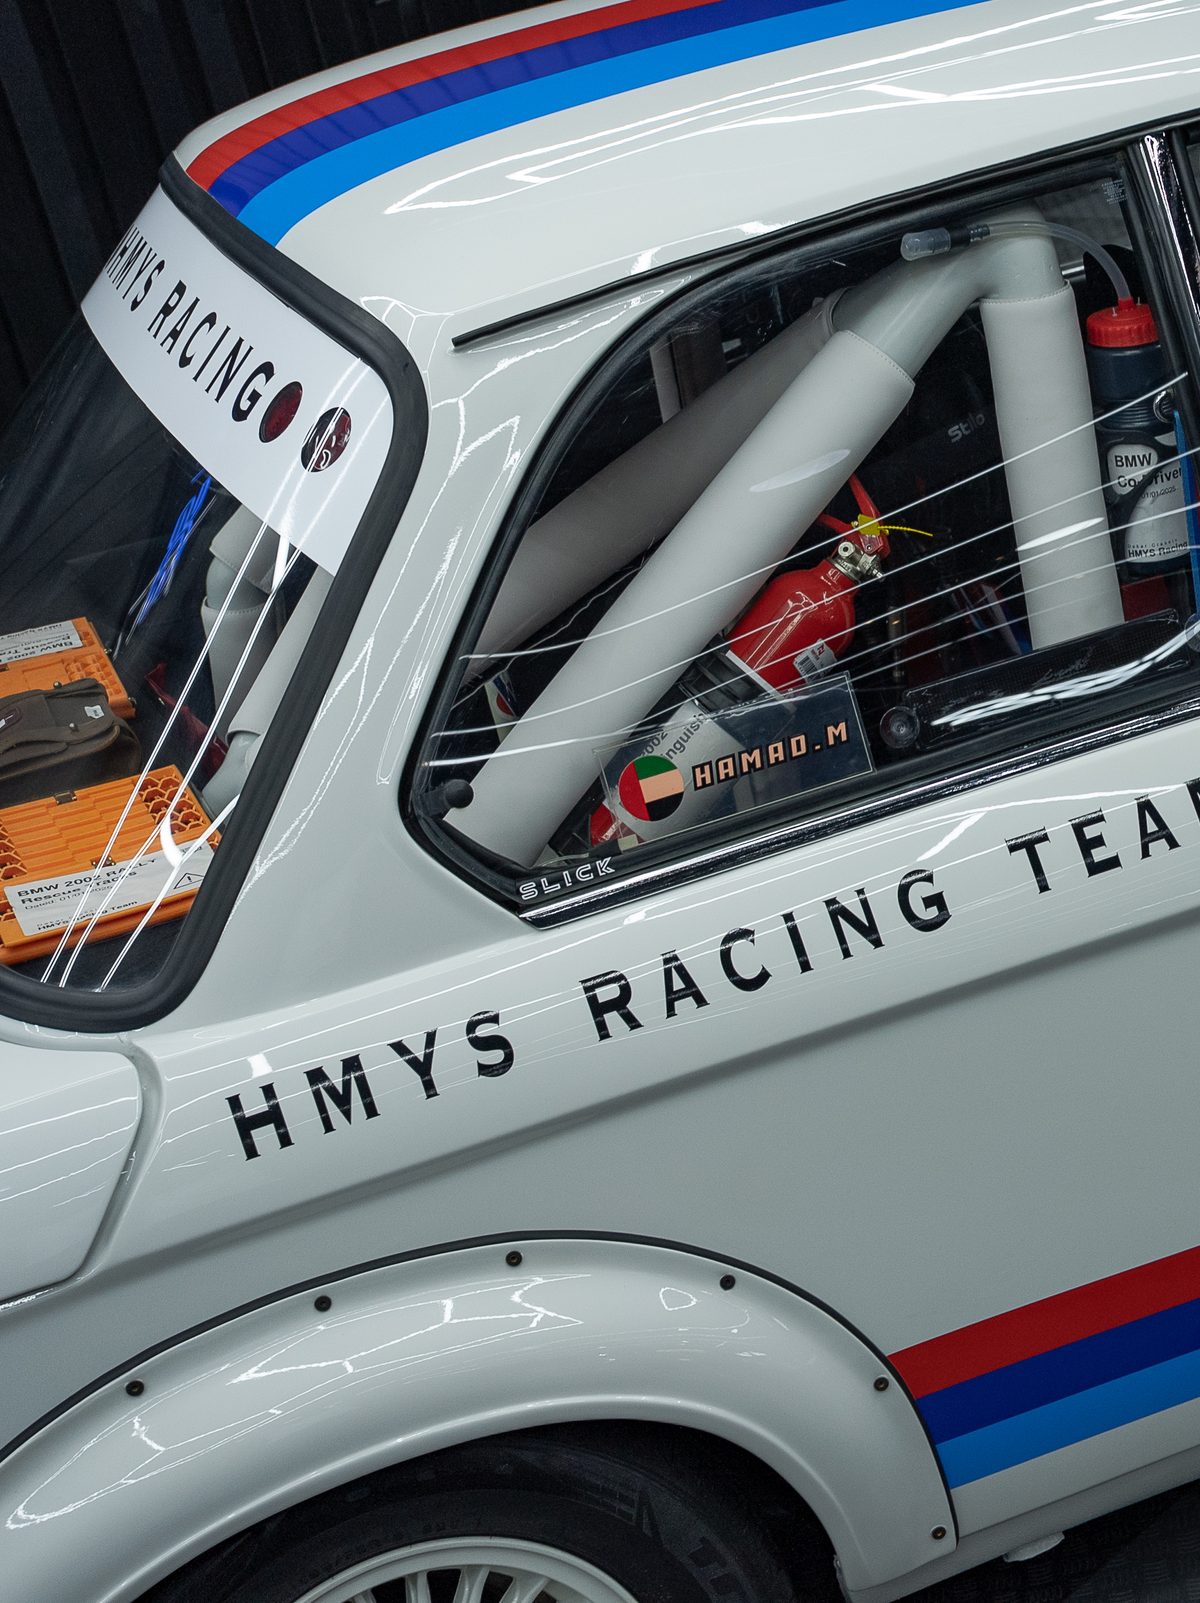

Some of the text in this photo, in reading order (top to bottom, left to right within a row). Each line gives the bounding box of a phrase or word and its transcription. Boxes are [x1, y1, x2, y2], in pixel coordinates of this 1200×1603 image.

[106, 226, 276, 422] HMYS RACING
[1114, 453, 1152, 468] BMW
[1128, 548, 1156, 558] HMYS
[519, 857, 615, 900] SLICK
[17, 883, 59, 898] BMW
[21, 887, 81, 905] Rescue
[112, 901, 138, 911] Team
[224, 1008, 517, 1160] HMYS
[578, 868, 954, 1041] RACING
